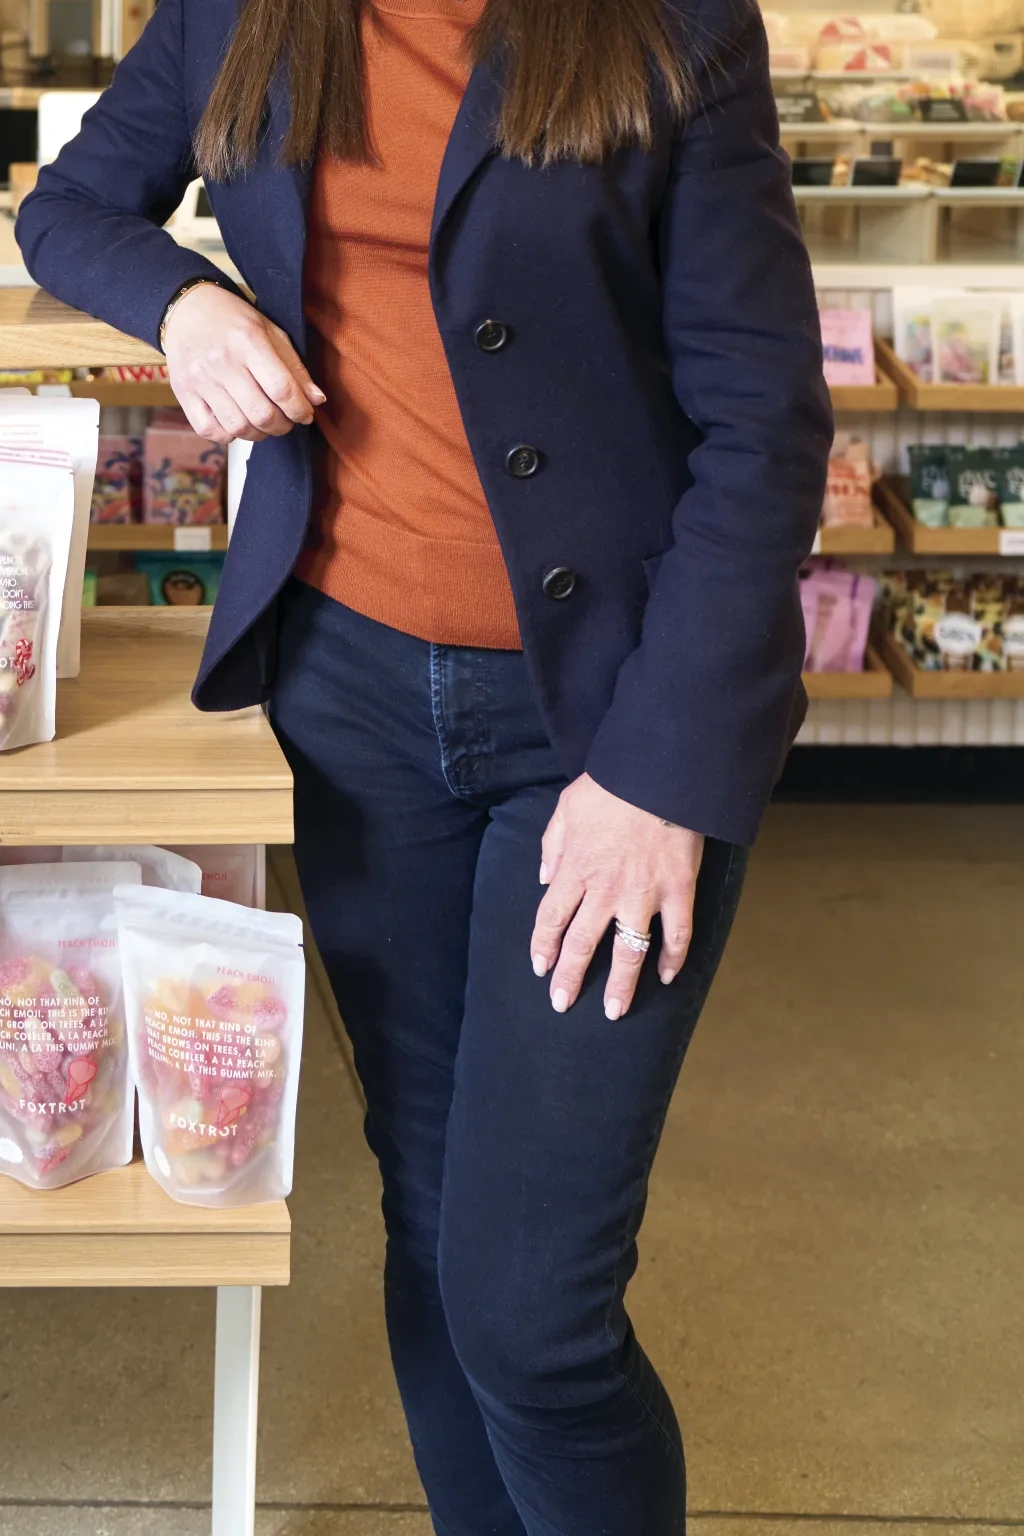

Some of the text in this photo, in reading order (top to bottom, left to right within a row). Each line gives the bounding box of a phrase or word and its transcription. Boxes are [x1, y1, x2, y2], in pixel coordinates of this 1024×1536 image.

[57, 940, 85, 949] PEACH
[216, 966, 275, 985] PEACH EMOJI
[19, 1099, 85, 1114] FOXTROT
[170, 1113, 238, 1136] FOXTROT
